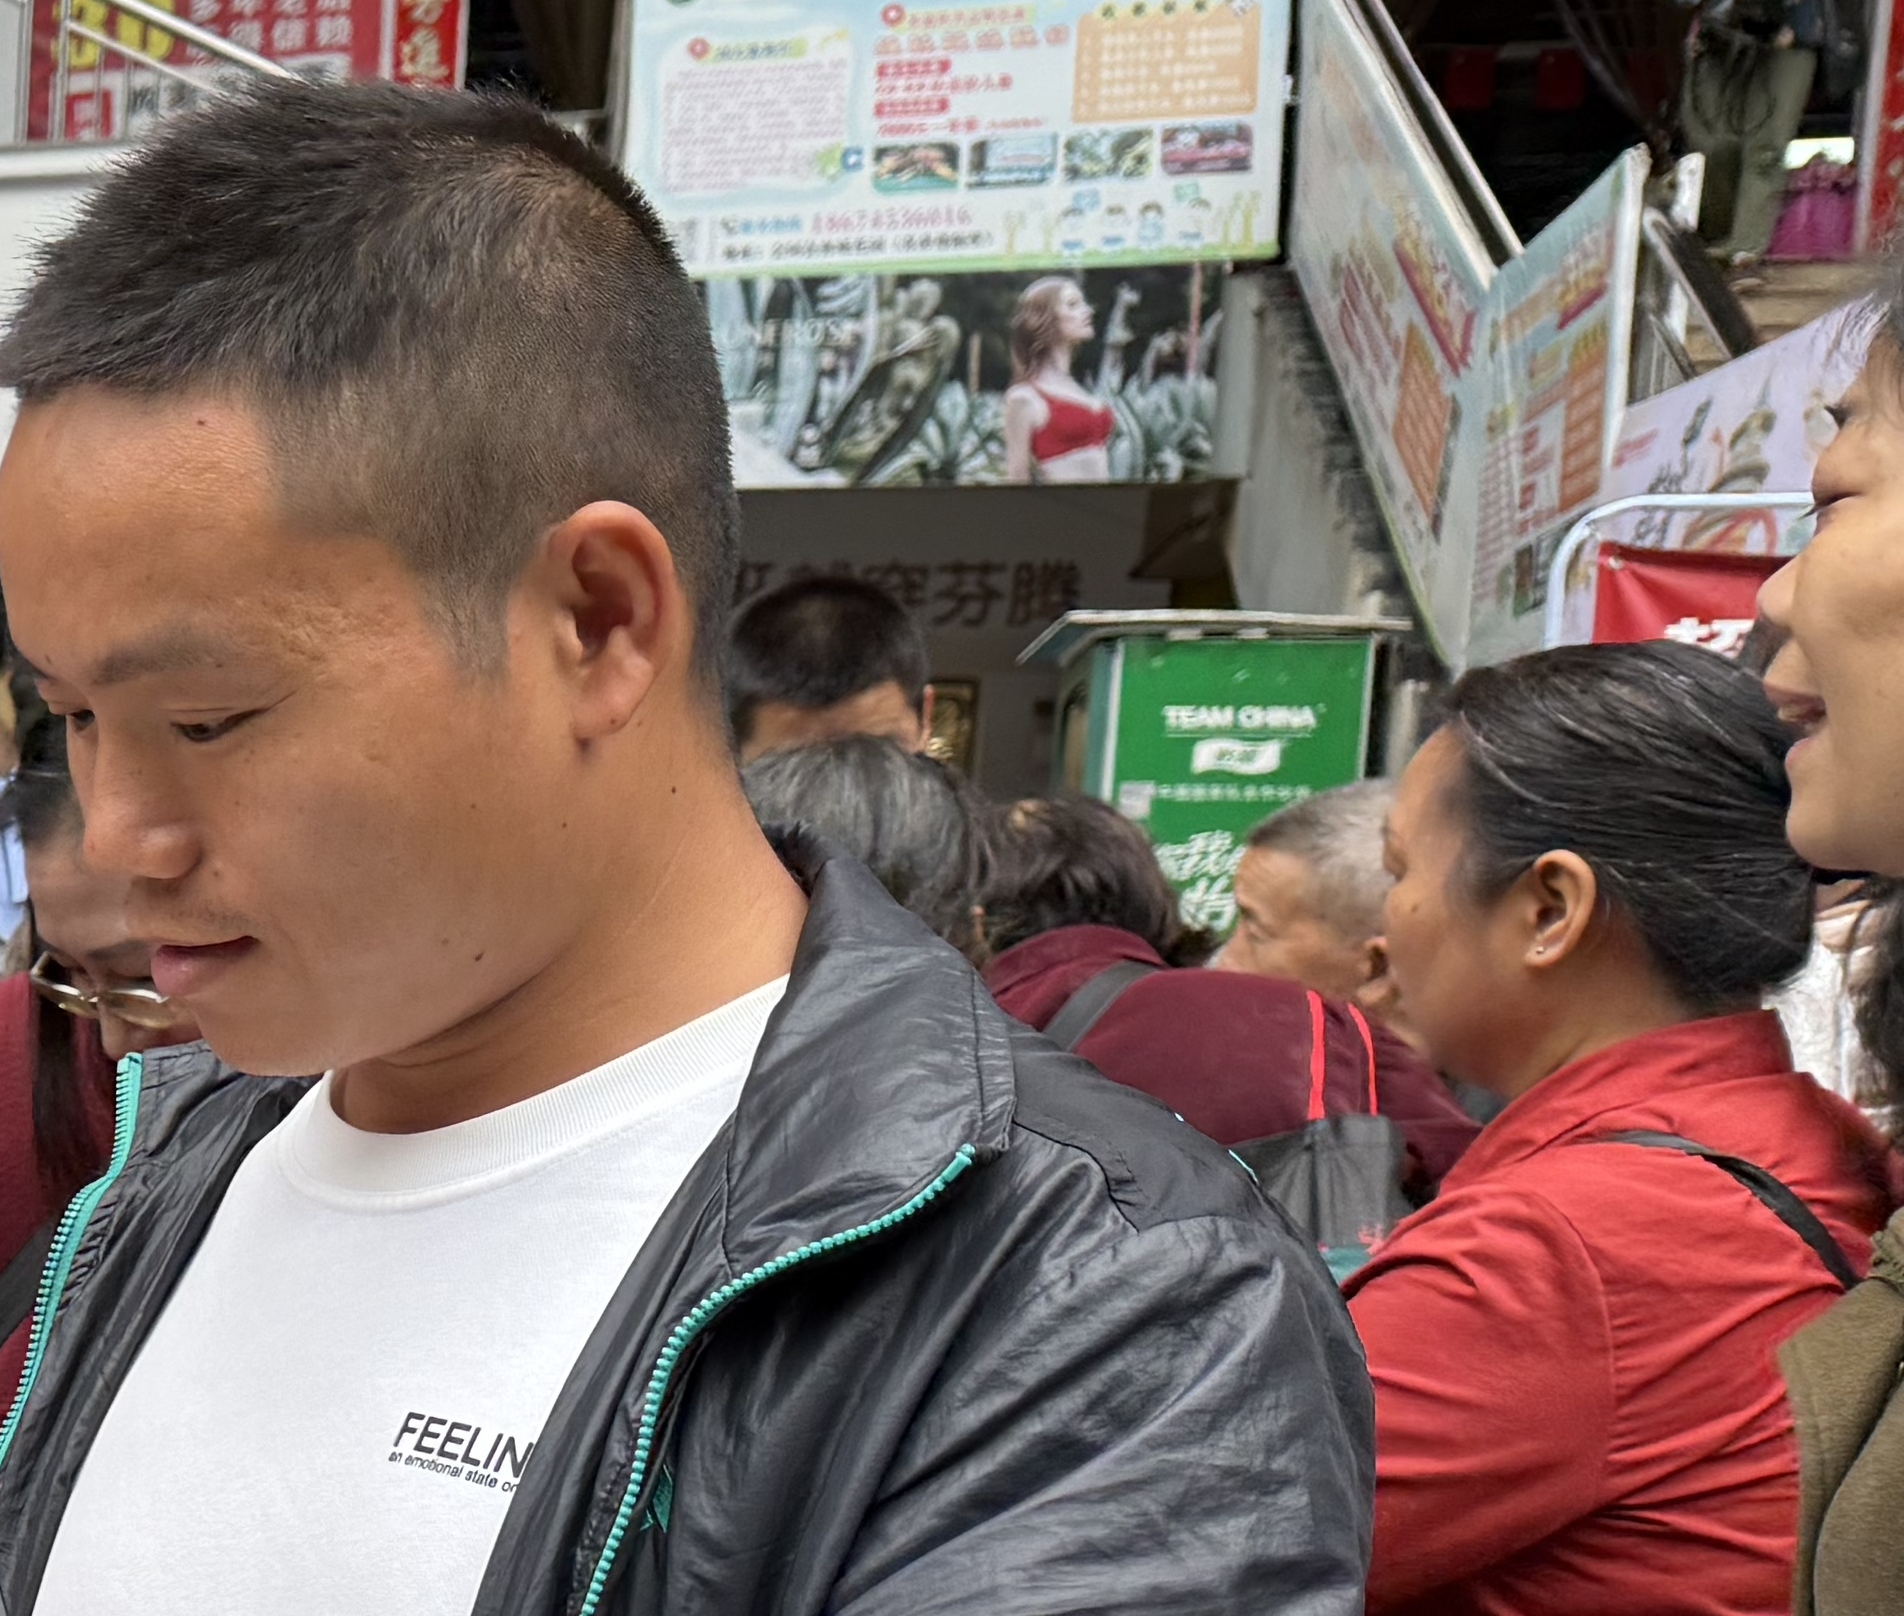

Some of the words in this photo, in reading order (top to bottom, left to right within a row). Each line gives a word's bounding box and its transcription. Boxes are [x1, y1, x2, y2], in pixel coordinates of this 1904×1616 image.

[1162, 704, 1234, 730] TEAM
[1238, 705, 1317, 729] CHINA
[404, 1453, 464, 1479] emotional
[465, 1469, 498, 1489] state
